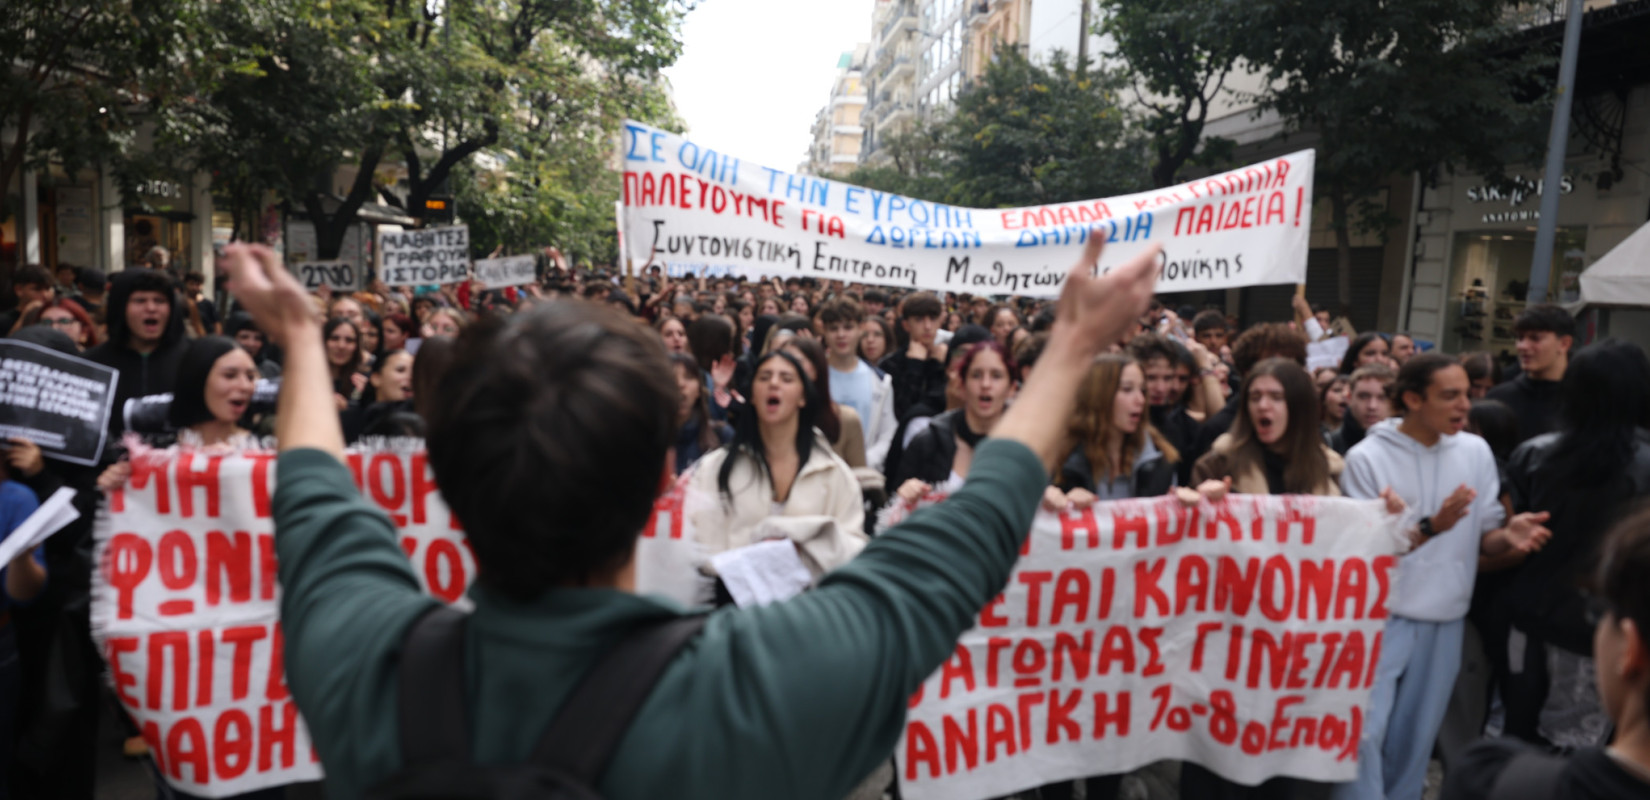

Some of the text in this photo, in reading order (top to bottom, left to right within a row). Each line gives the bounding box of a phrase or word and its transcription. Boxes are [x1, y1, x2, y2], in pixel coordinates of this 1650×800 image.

[624, 171, 786, 227] ΠΑΛΕΥΟΥΜΕ
[802, 209, 845, 239] ΓΙΑ
[866, 225, 982, 248] ΔΩΡΕΑΝ
[625, 124, 667, 163] ΣΕ
[679, 141, 740, 186] ΟΛΗ
[762, 166, 829, 207] ΤΗΝ
[845, 187, 973, 230] ΕΥΡΩΠΗ
[1001, 201, 1112, 230] ΕΛΛΑΔΑ
[1188, 159, 1291, 199] ΓΑΛΛΙΑ
[381, 230, 465, 251] ΜΑΘΗΤΕΣ
[384, 263, 468, 282] ΙΣΤΟΡΙΑ
[813, 241, 918, 285] Επιτροπή
[945, 255, 1066, 292] Μαθητών
[1132, 553, 1397, 623] ΚΑΝΟΝΑΣ
[940, 622, 1384, 698] ΑΓΩΝΑΣ ΓΙΝΕΤΑΙ
[904, 688, 1132, 782] ΑΝΑΓΚΗ
